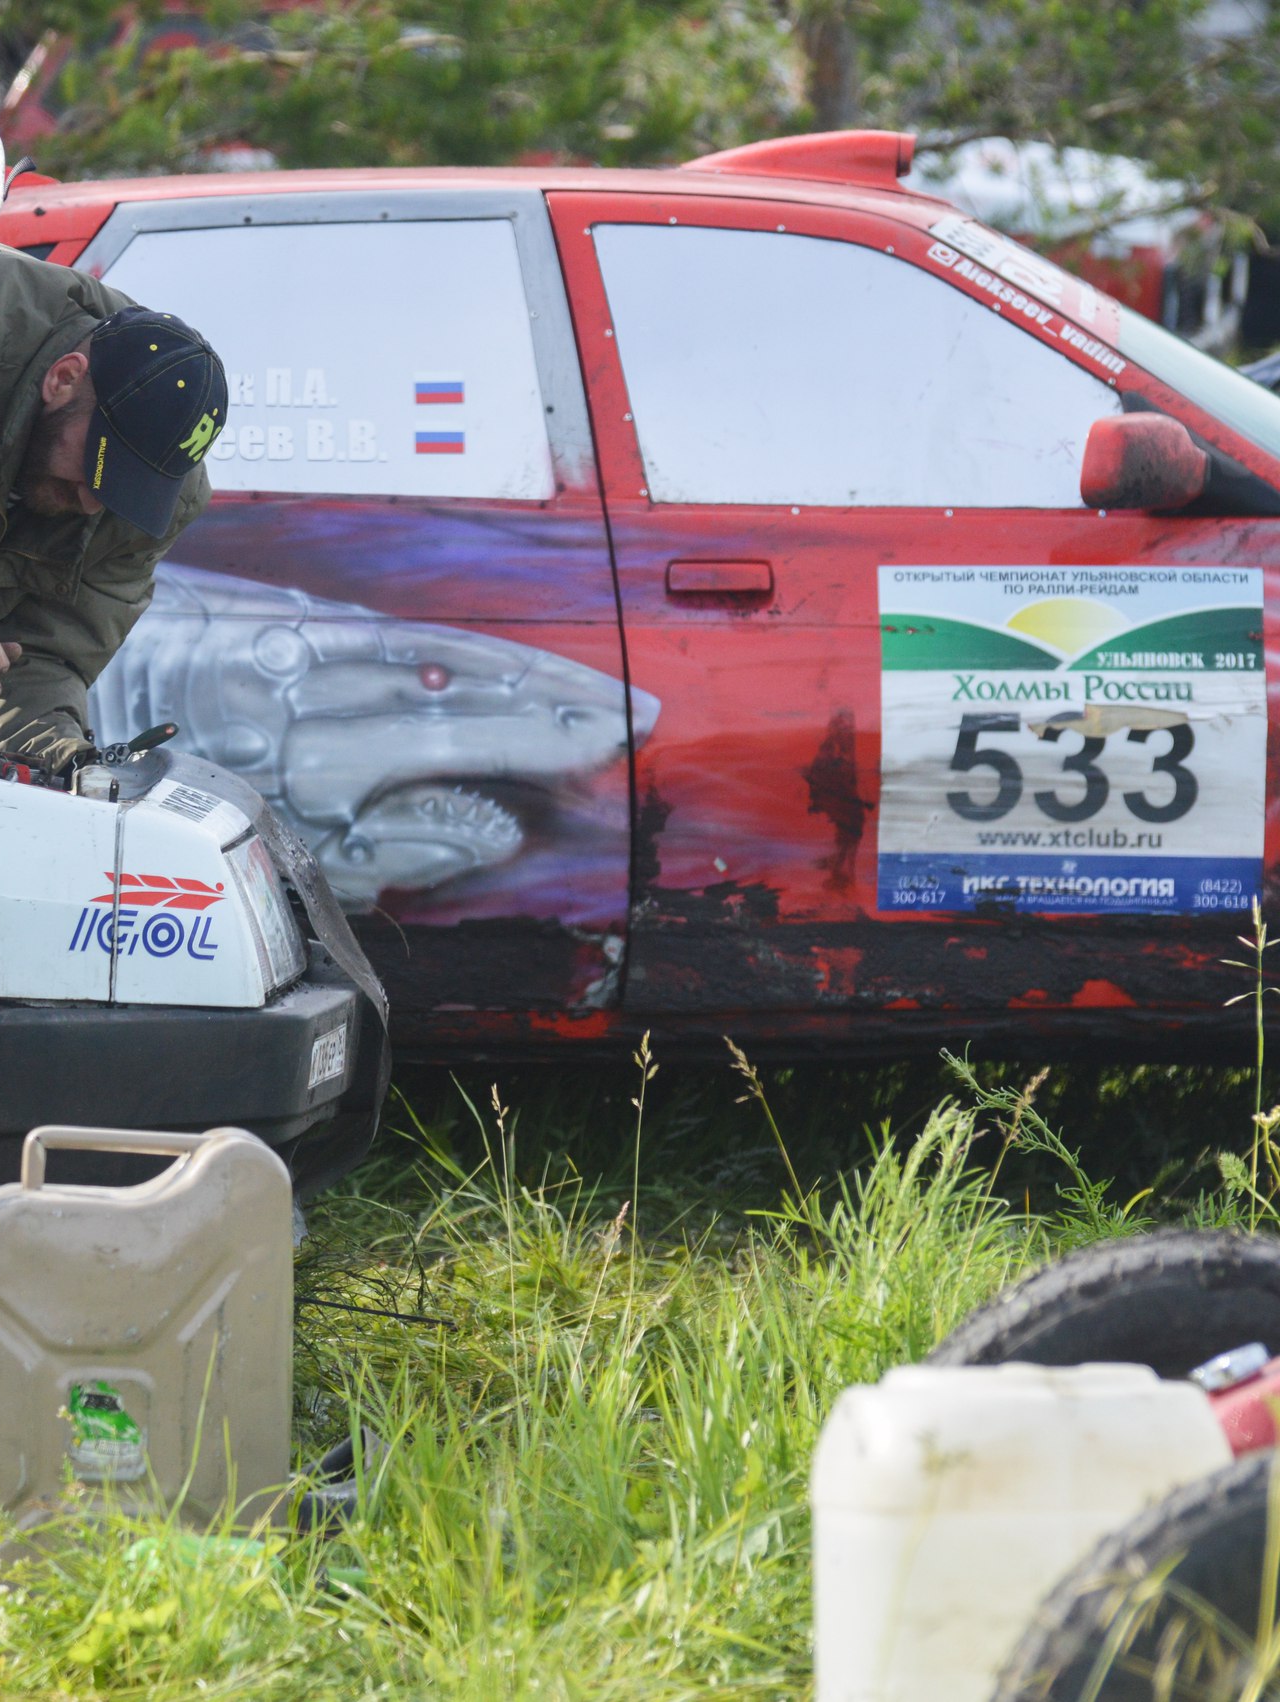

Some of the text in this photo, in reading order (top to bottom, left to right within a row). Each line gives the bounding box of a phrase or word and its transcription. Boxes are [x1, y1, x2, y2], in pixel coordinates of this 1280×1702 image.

[894, 569, 1249, 584] ОТКРЫТЫЙ ЧЕМПИОНАТ УЛЬЯНОВСКОЙ ОБЛАСТИ
[1004, 583, 1139, 596] ПО РАЛЛИ-РЕЙДАМ
[1095, 651, 1257, 669] УЛЬЯНОВСК 2017
[951, 673, 1194, 702] Холмы России
[945, 710, 1199, 824] 533
[976, 828, 1163, 849] www.xtclub.ru
[1200, 878, 1243, 895] (8422)
[892, 891, 946, 905] 300-617
[1192, 893, 1249, 910] 300-618
[68, 907, 219, 961] IGOL
